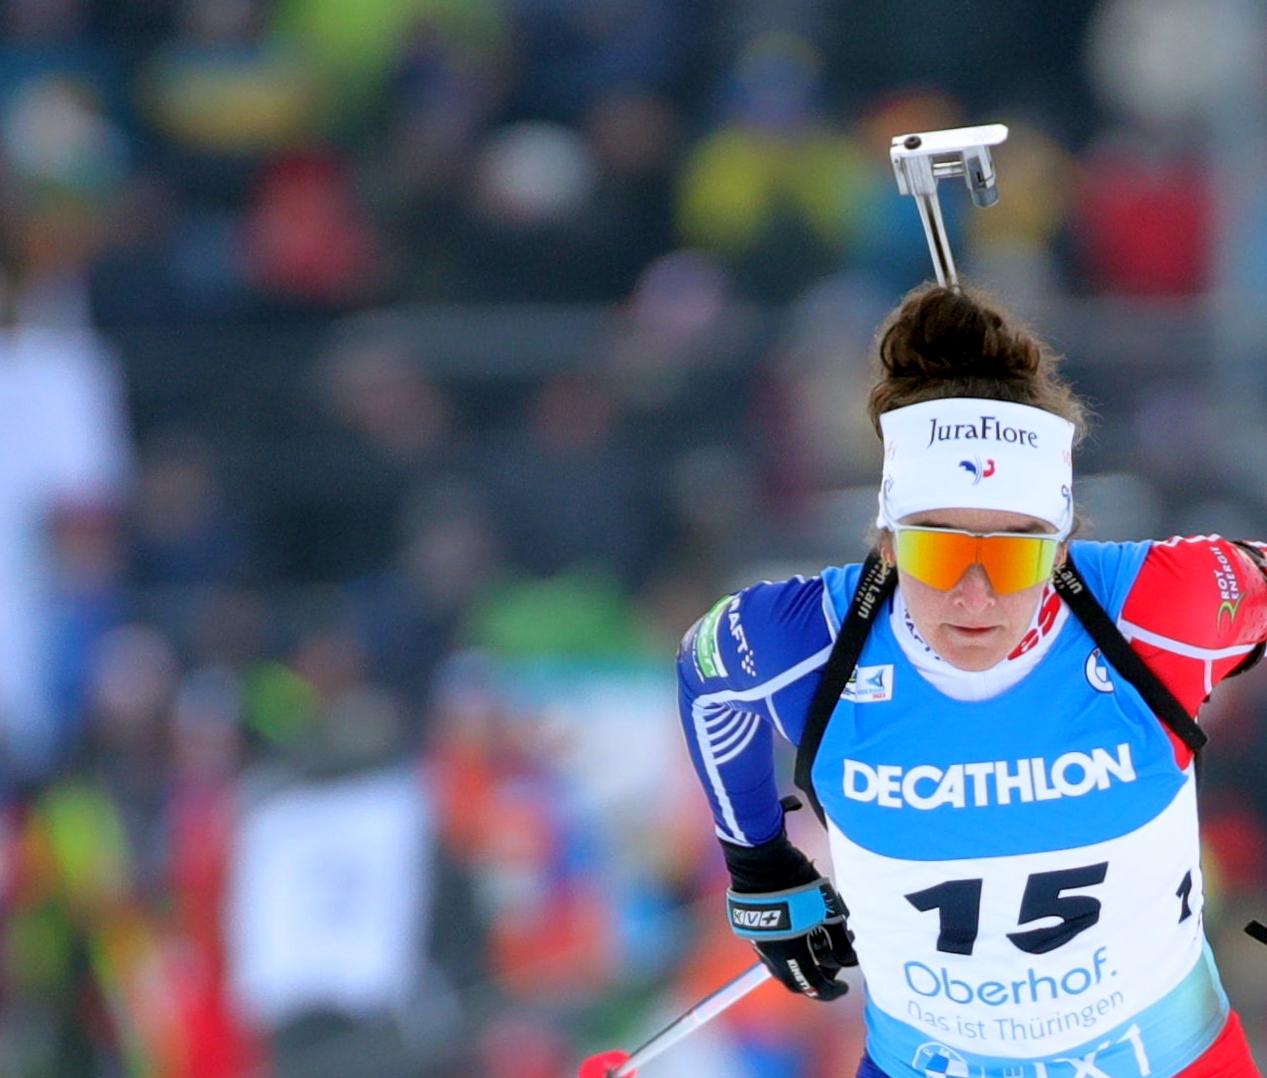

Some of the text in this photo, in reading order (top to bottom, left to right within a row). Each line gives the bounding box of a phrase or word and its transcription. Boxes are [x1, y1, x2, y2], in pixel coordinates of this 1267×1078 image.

[927, 416, 1038, 448] JuraFlore
[1213, 569, 1230, 600] ROY
[728, 590, 749, 653] RAFT
[842, 743, 1137, 811] DECATHLON
[903, 861, 1109, 956] 15
[907, 990, 1125, 1042] Das ist Thüringen
